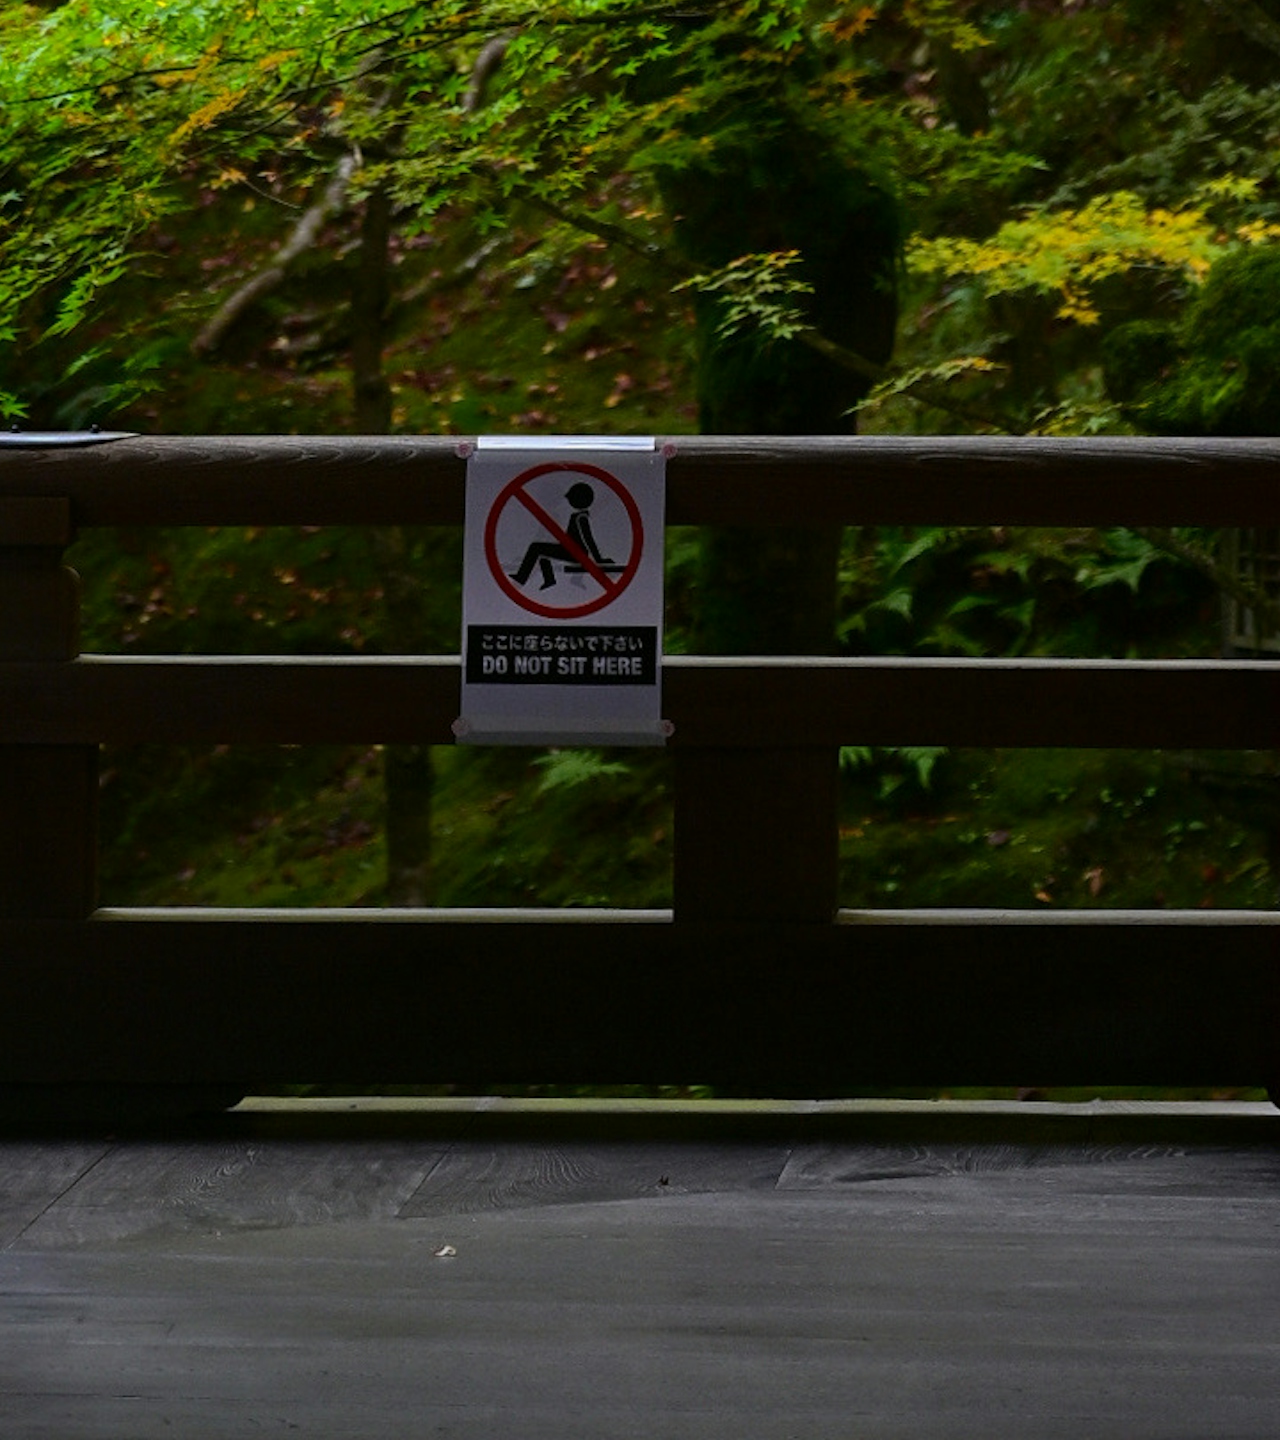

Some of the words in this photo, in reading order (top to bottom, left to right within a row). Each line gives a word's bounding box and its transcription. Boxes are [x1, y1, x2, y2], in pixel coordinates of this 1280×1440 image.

[481, 634, 643, 651] ここに座らないで下さい
[482, 656, 508, 675] DO
[514, 656, 552, 675] NOT
[557, 656, 587, 675] SIT
[593, 656, 643, 675] HERE
